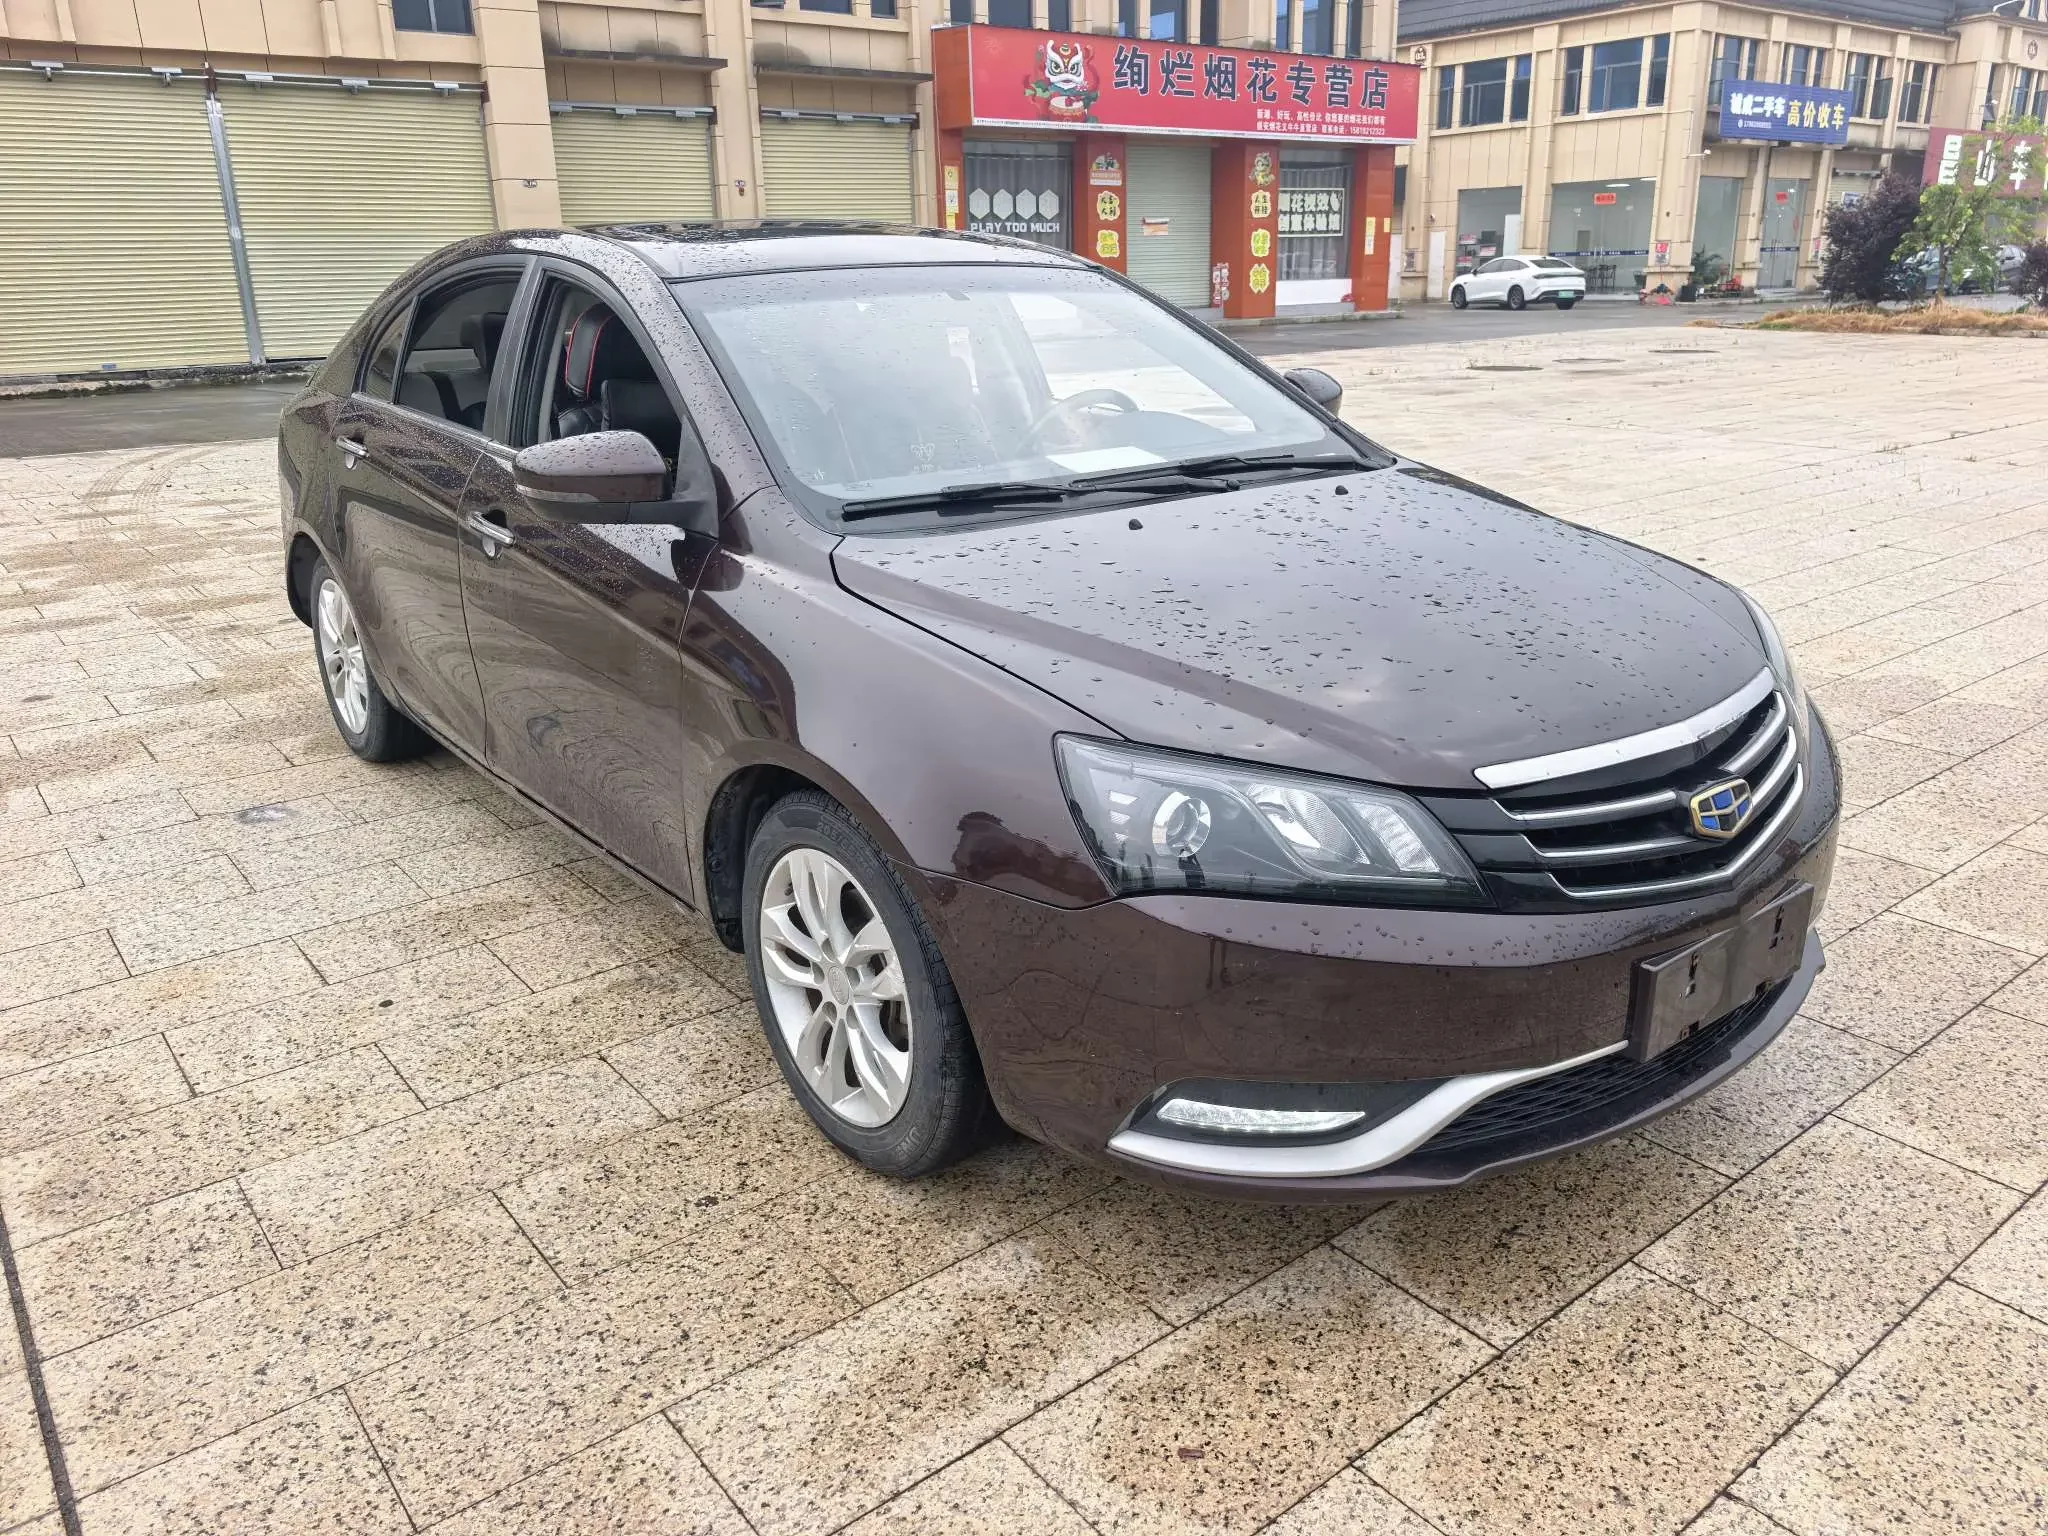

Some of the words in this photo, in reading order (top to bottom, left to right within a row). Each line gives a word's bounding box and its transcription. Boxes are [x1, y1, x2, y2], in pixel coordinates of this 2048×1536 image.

[1113, 44, 1389, 110] 绚烂烟花专营店
[1787, 100, 1845, 130] 高价收车
[970, 222, 1001, 232] PLAY
[1005, 222, 1027, 233] TOO
[1031, 222, 1060, 233] MUCH
